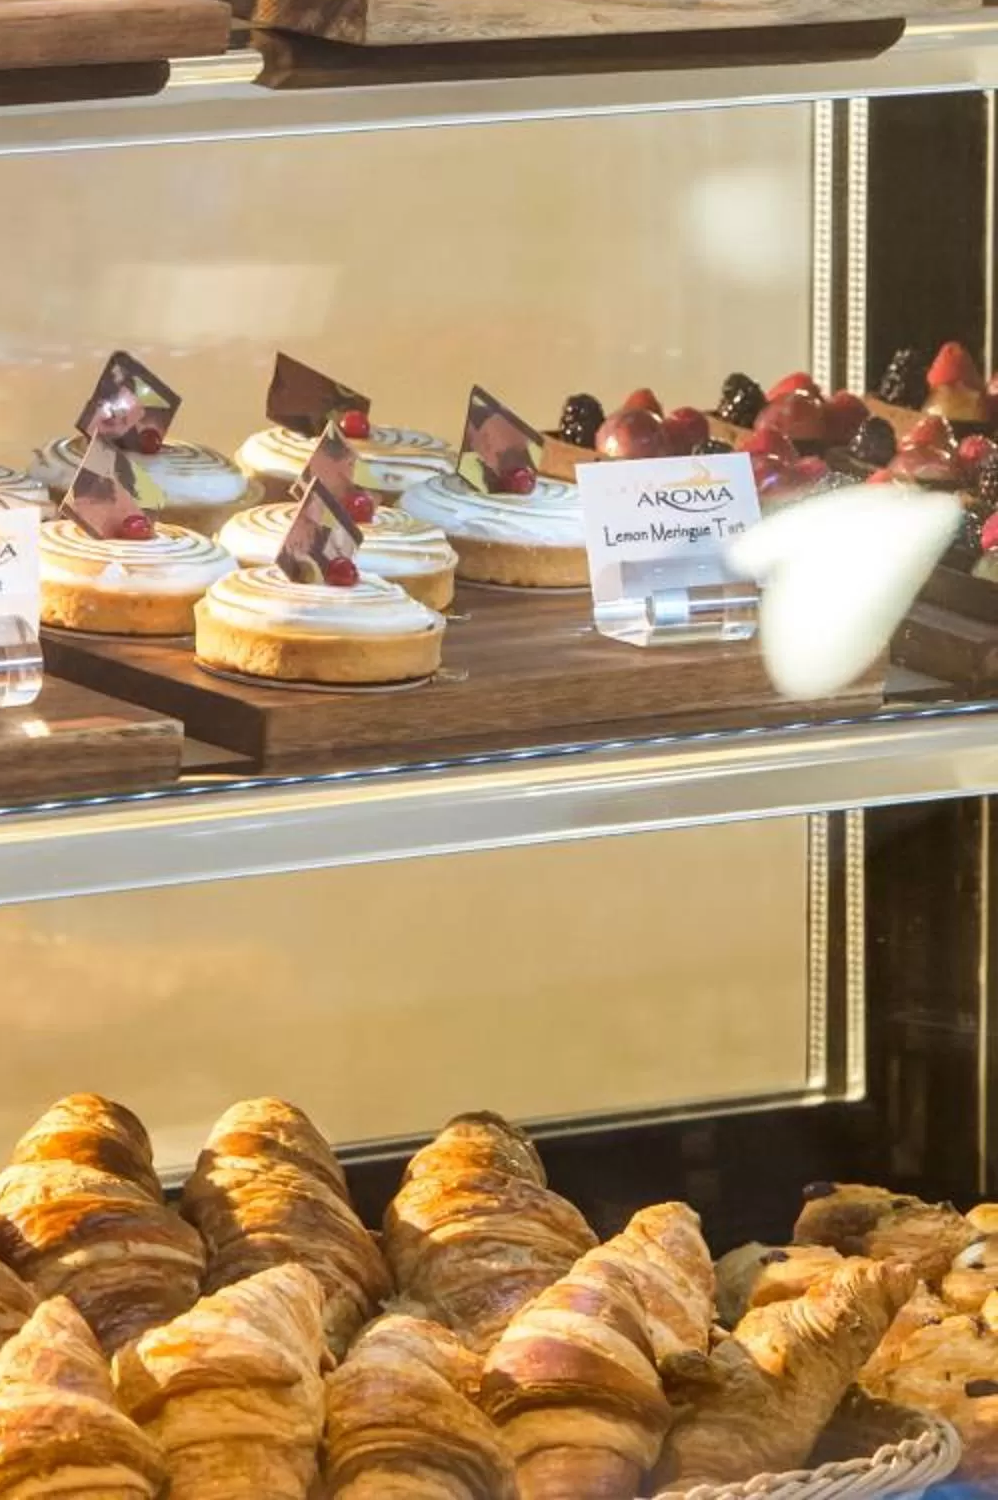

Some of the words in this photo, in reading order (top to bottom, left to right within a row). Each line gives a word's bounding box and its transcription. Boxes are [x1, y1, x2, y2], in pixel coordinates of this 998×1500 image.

[637, 487, 734, 513] AROMA
[603, 524, 649, 547] Lemon
[650, 522, 712, 543] Meringue
[712, 517, 746, 540] Tart
